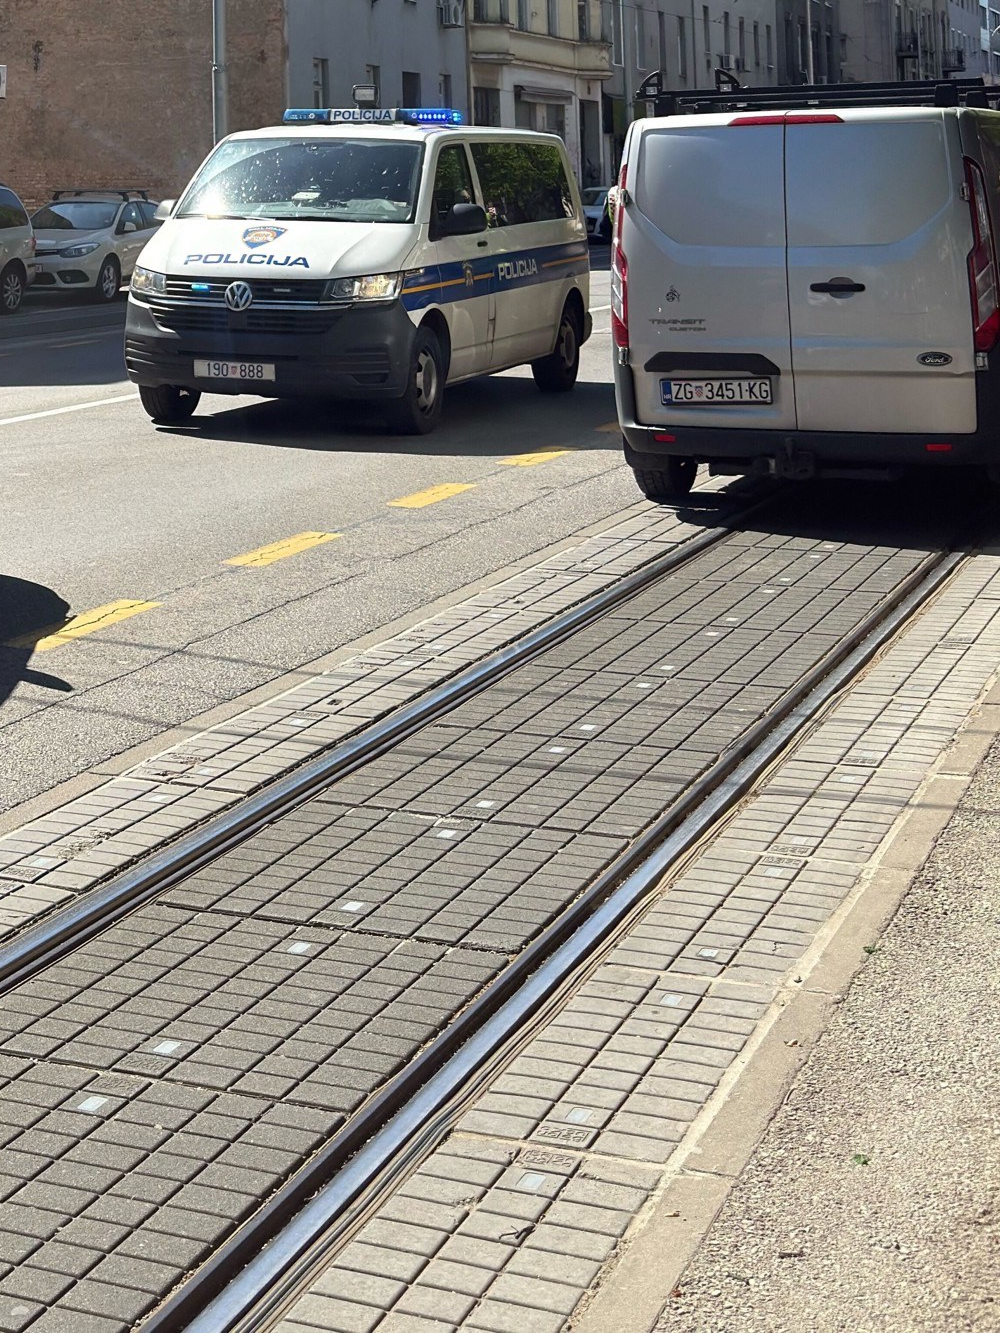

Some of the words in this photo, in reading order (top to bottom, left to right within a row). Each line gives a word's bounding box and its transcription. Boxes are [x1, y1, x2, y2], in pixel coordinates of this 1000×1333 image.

[333, 110, 392, 120] POLICIJA
[184, 254, 310, 269] POLICIJA
[497, 258, 539, 281] POLICIJA
[207, 362, 229, 377] 190
[240, 364, 264, 379] 888
